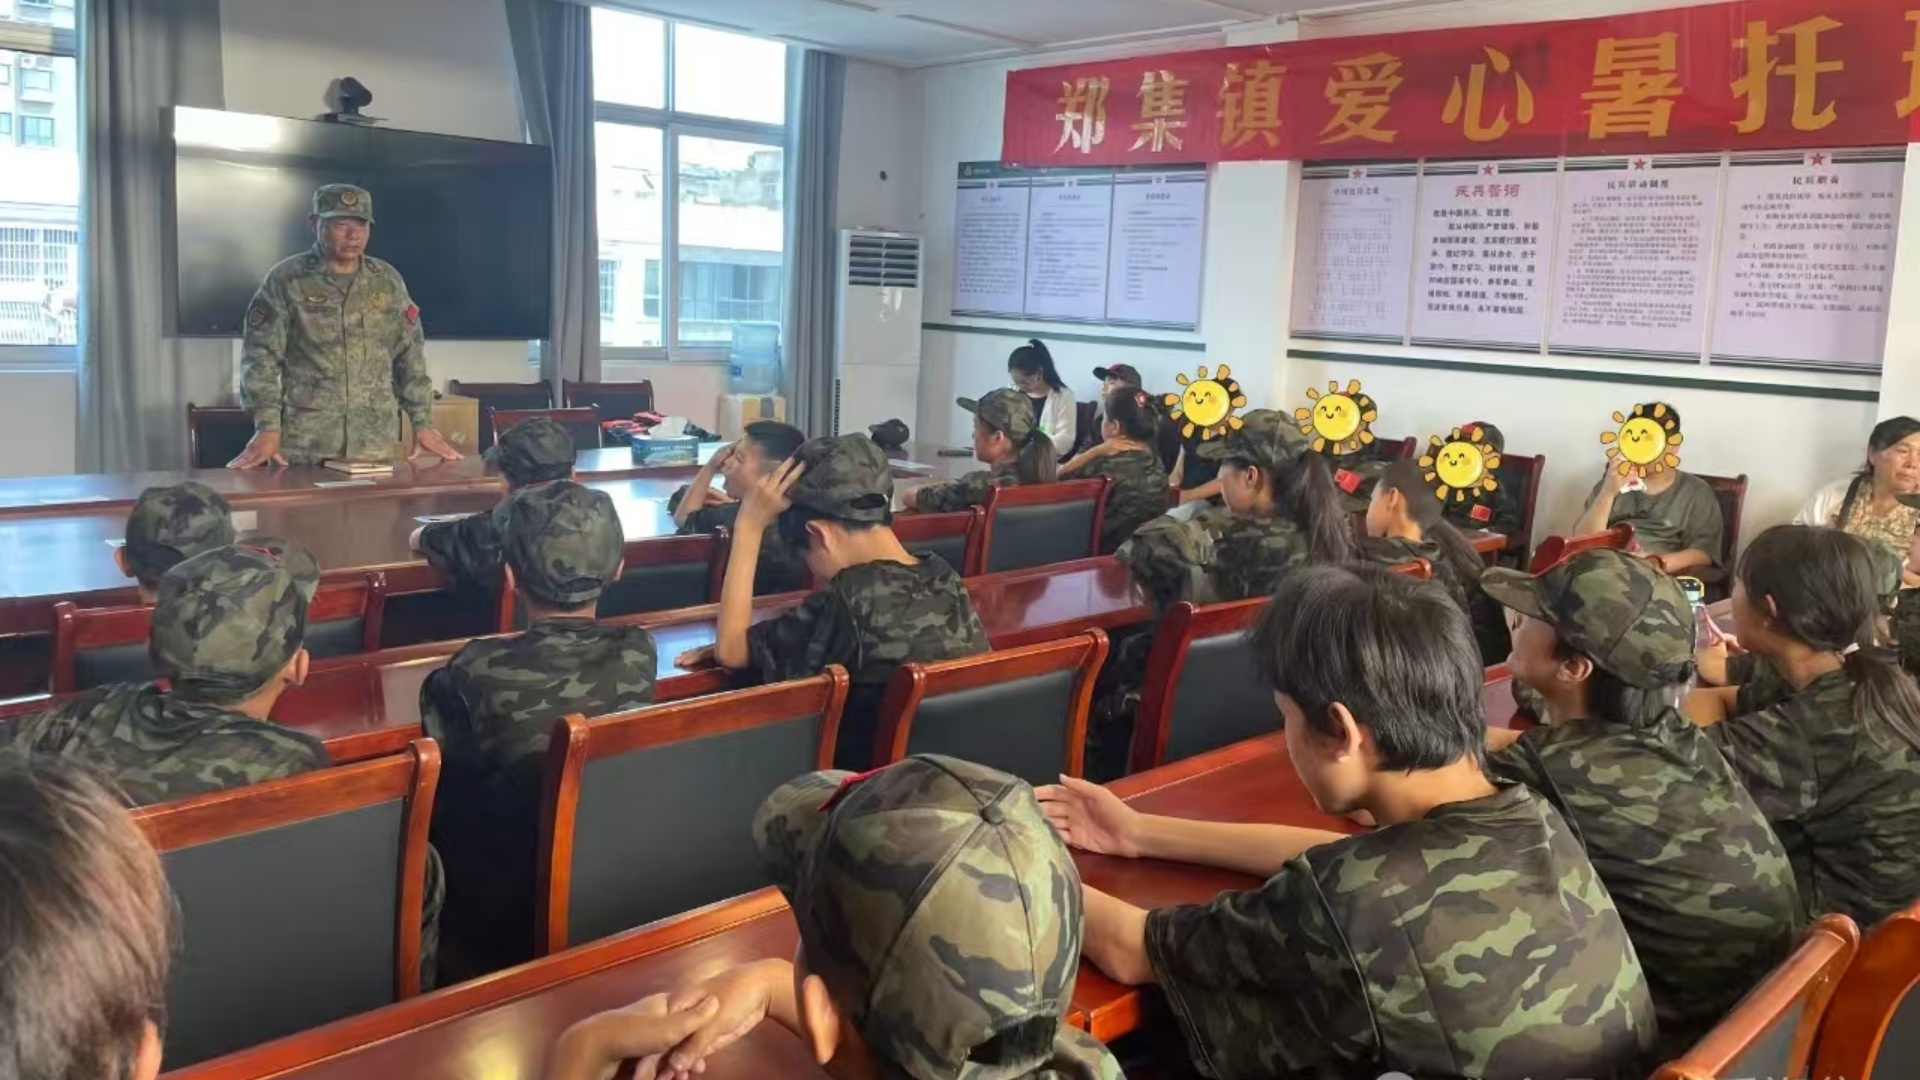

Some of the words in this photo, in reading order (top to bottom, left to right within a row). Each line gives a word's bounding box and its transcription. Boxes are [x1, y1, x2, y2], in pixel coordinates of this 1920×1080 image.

[1055, 8, 1920, 155] 郑集镇爱心暑托
